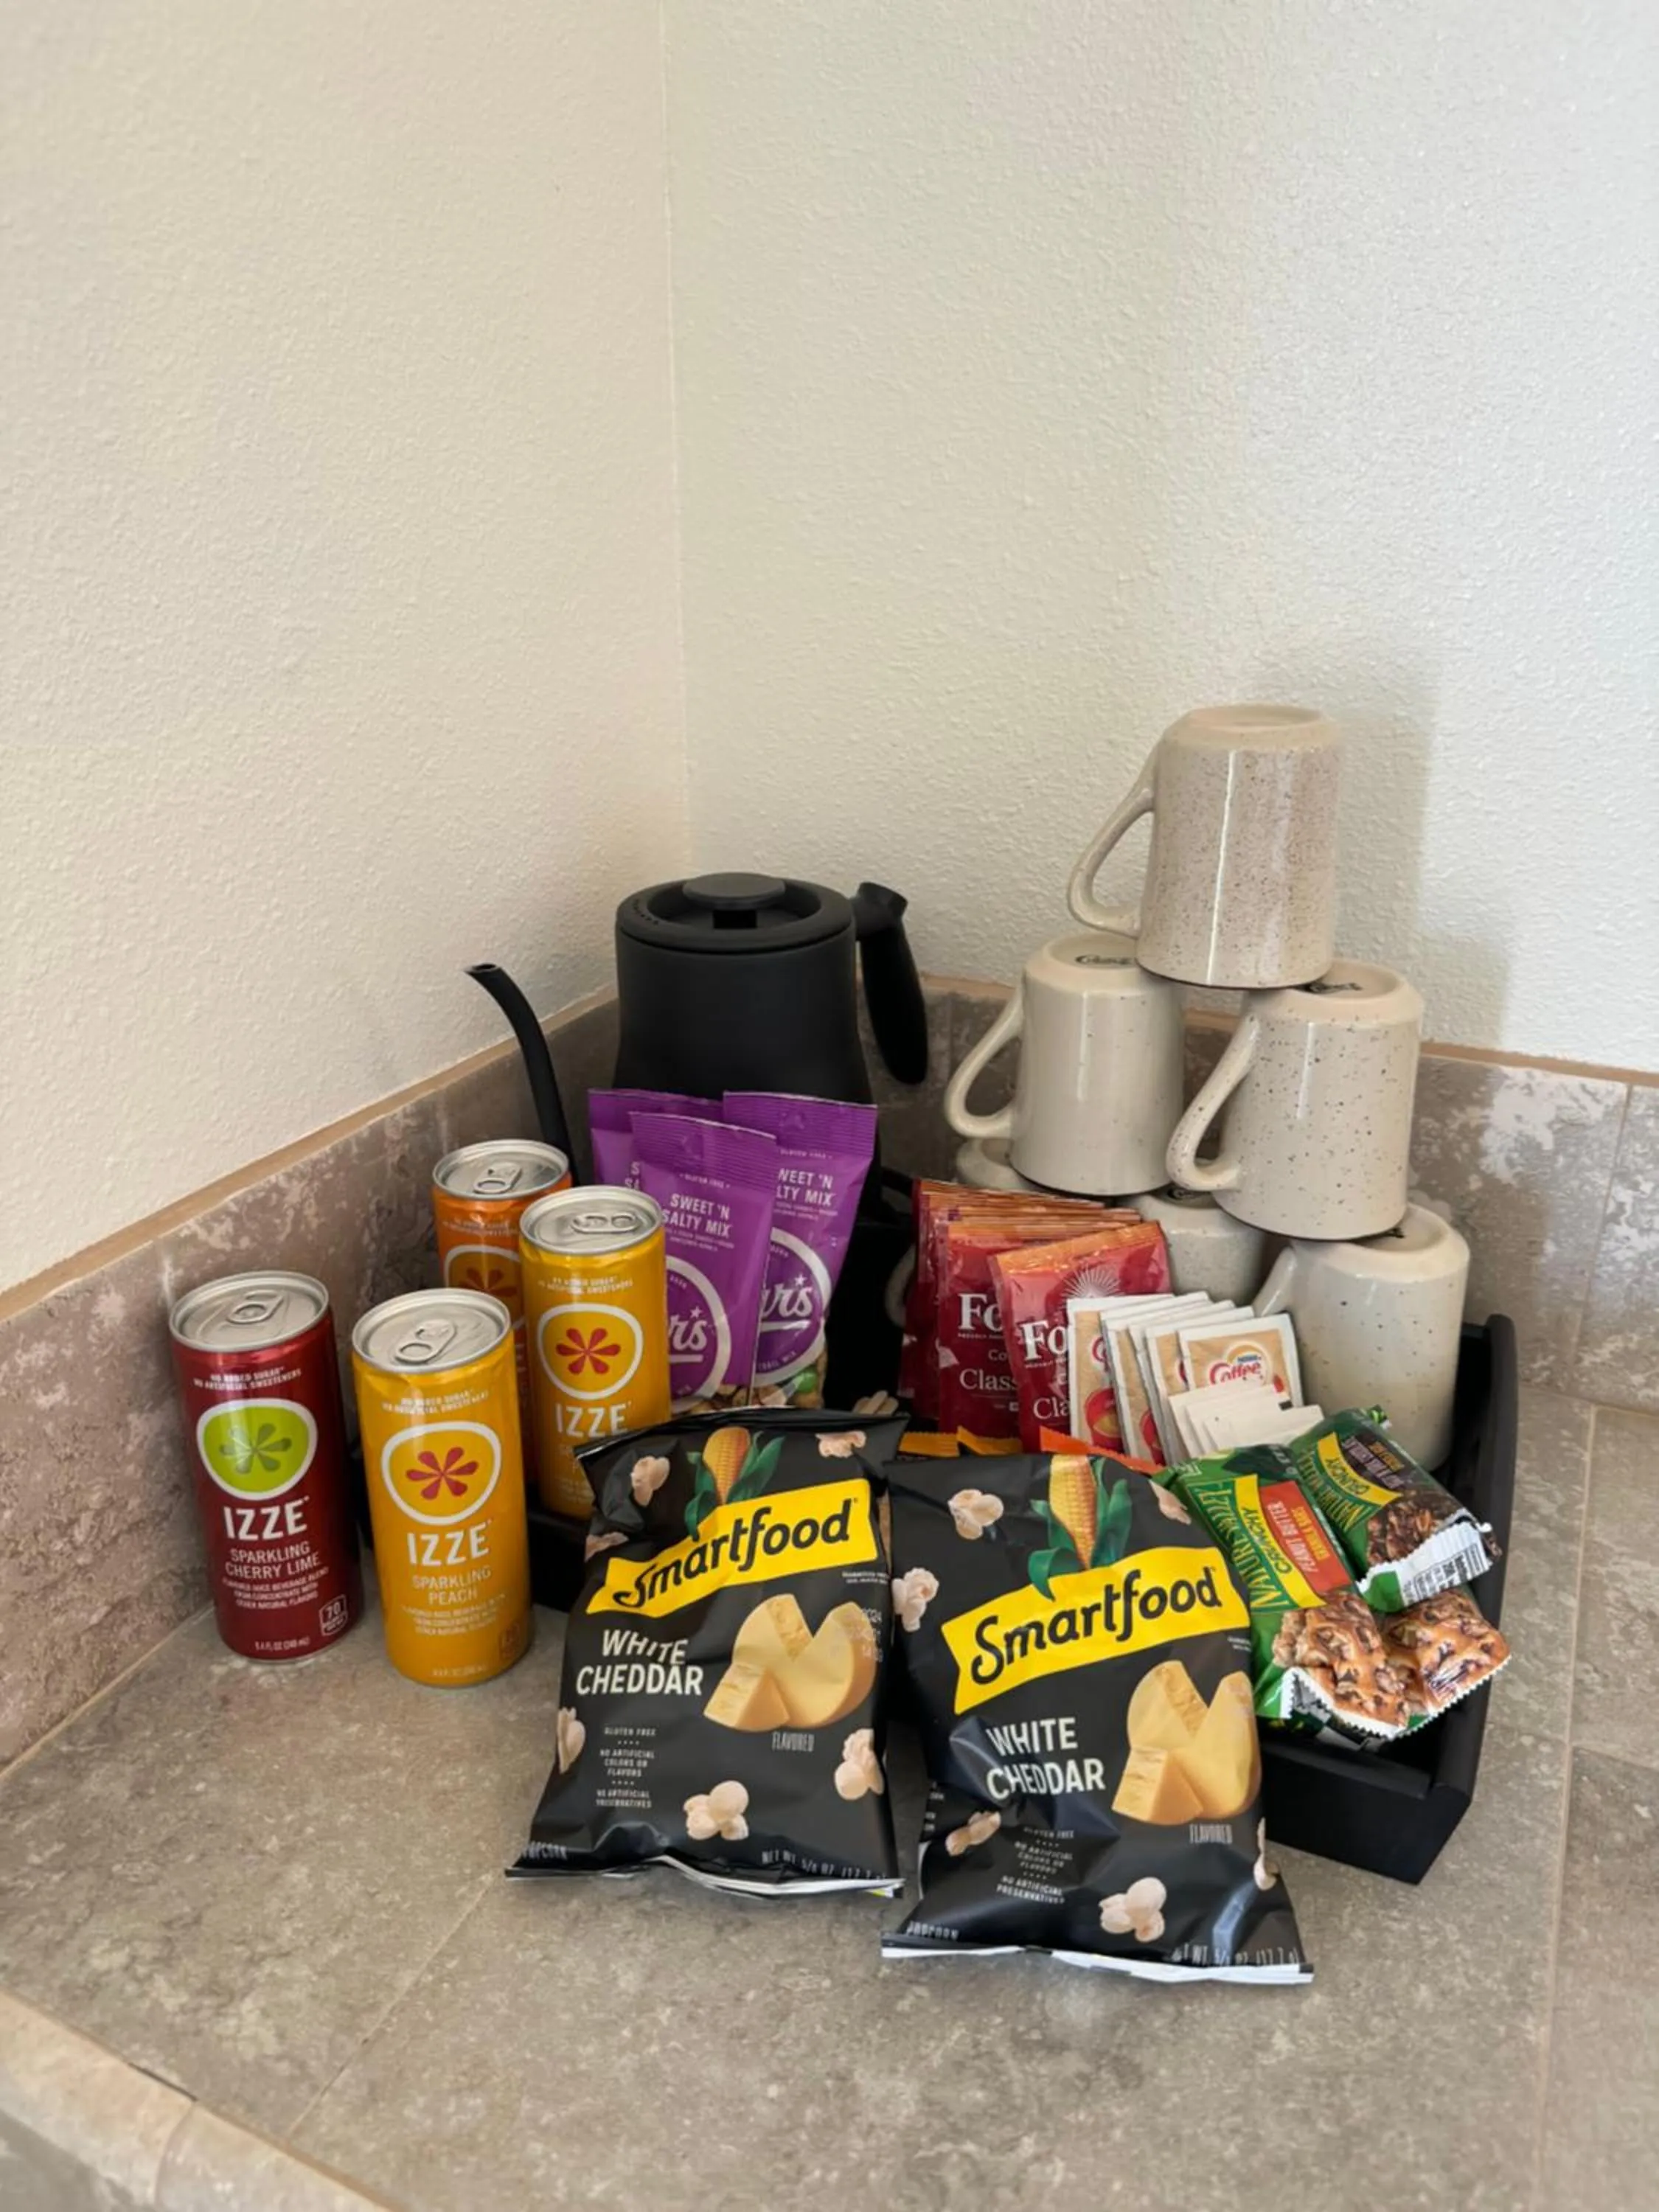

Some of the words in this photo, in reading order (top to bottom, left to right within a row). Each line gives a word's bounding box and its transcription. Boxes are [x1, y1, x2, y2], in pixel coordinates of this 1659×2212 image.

[670, 1193, 714, 1215] SWEET
[804, 1189, 836, 1207] MIX
[662, 1209, 702, 1230] SALTY
[706, 1220, 733, 1239] MIX
[556, 1403, 628, 1438] IZZE
[223, 1498, 307, 1541] IZZE
[230, 1540, 310, 1563] SPARKLING
[407, 1522, 490, 1567] IZZE
[613, 1498, 853, 1609] Smartfood
[1242, 1509, 1292, 1575] CRUNCHY
[225, 1562, 282, 1579] CHERRY
[287, 1552, 320, 1576] LIME
[411, 1565, 492, 1589] SPARKLING
[1231, 1536, 1289, 1608] NATURE
[428, 1589, 478, 1606] PEACH
[971, 1566, 1222, 1685] Smartfood
[601, 1629, 689, 1666] WHITE
[576, 1664, 704, 1696] CHEDDAR
[772, 1731, 815, 1752] FLAVORED
[987, 1717, 1078, 1757] WHITE
[987, 1759, 1105, 1799] CHEDDAR
